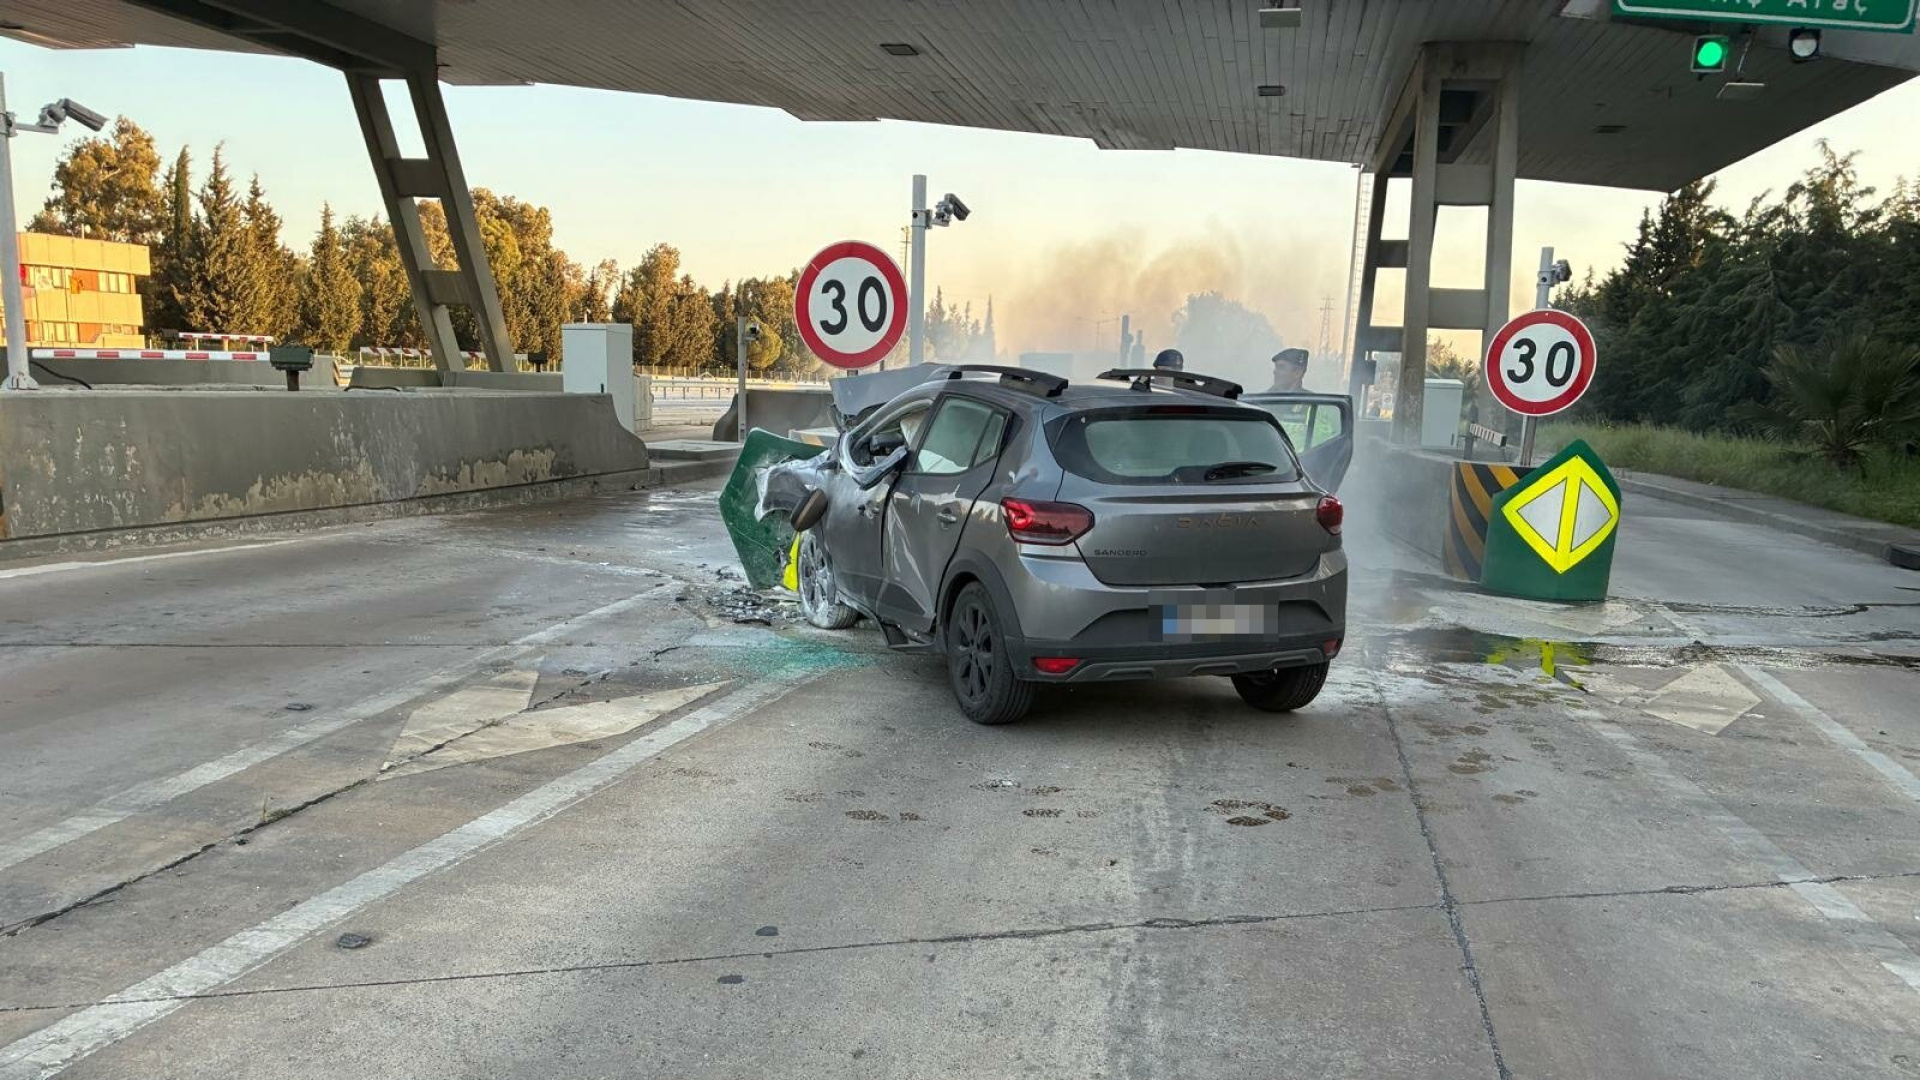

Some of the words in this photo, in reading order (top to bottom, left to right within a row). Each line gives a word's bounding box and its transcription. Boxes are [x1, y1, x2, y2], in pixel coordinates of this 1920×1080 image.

[820, 276, 887, 335] 30
[1507, 338, 1575, 387] 30
[1094, 549, 1148, 557] SANDERO
